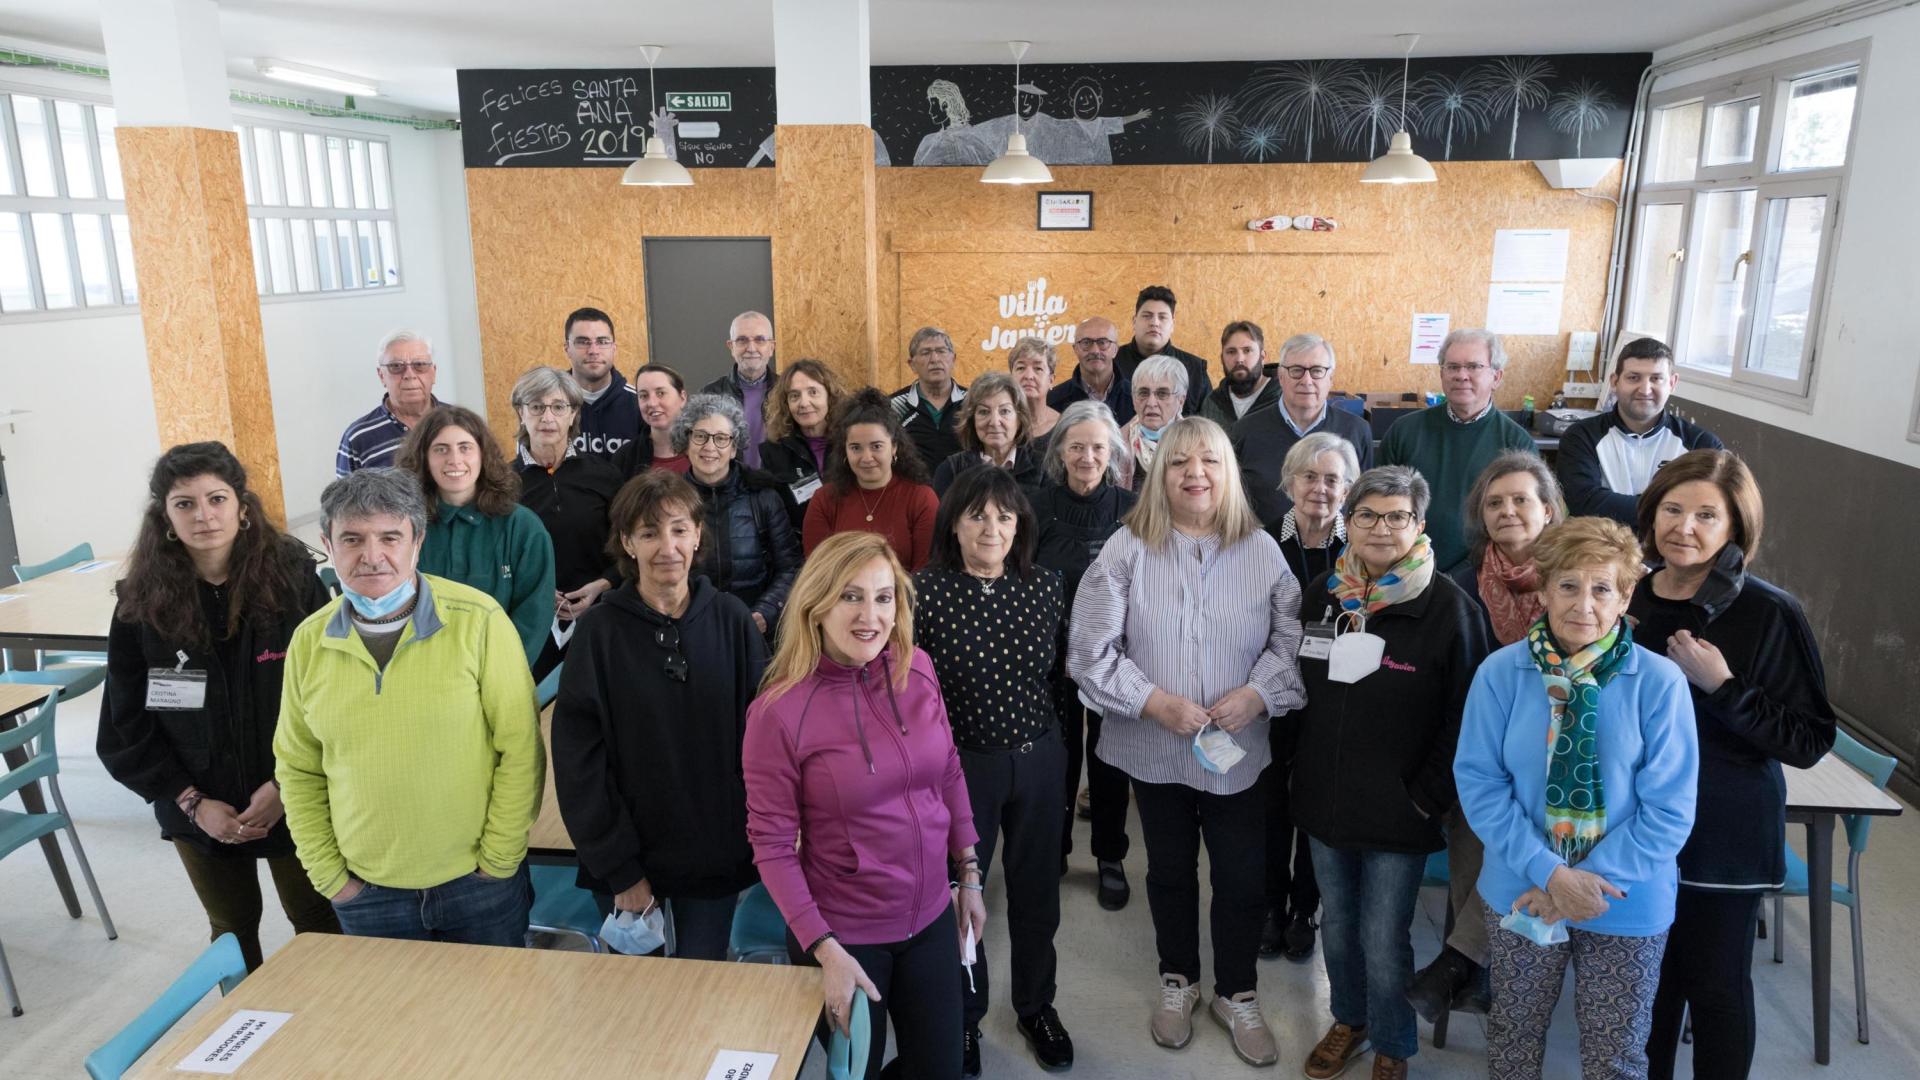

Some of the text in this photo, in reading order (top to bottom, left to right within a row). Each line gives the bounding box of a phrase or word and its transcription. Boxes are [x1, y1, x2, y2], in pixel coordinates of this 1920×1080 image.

[573, 77, 638, 99] SANTA
[687, 96, 727, 107] SALIDA
[577, 98, 633, 125] ANA
[580, 124, 647, 154] 2019
[695, 152, 714, 165] NO
[999, 277, 1067, 318] Villa
[204, 1019, 256, 1061] FERRADORES
[219, 1031, 255, 1061] ANGELES
